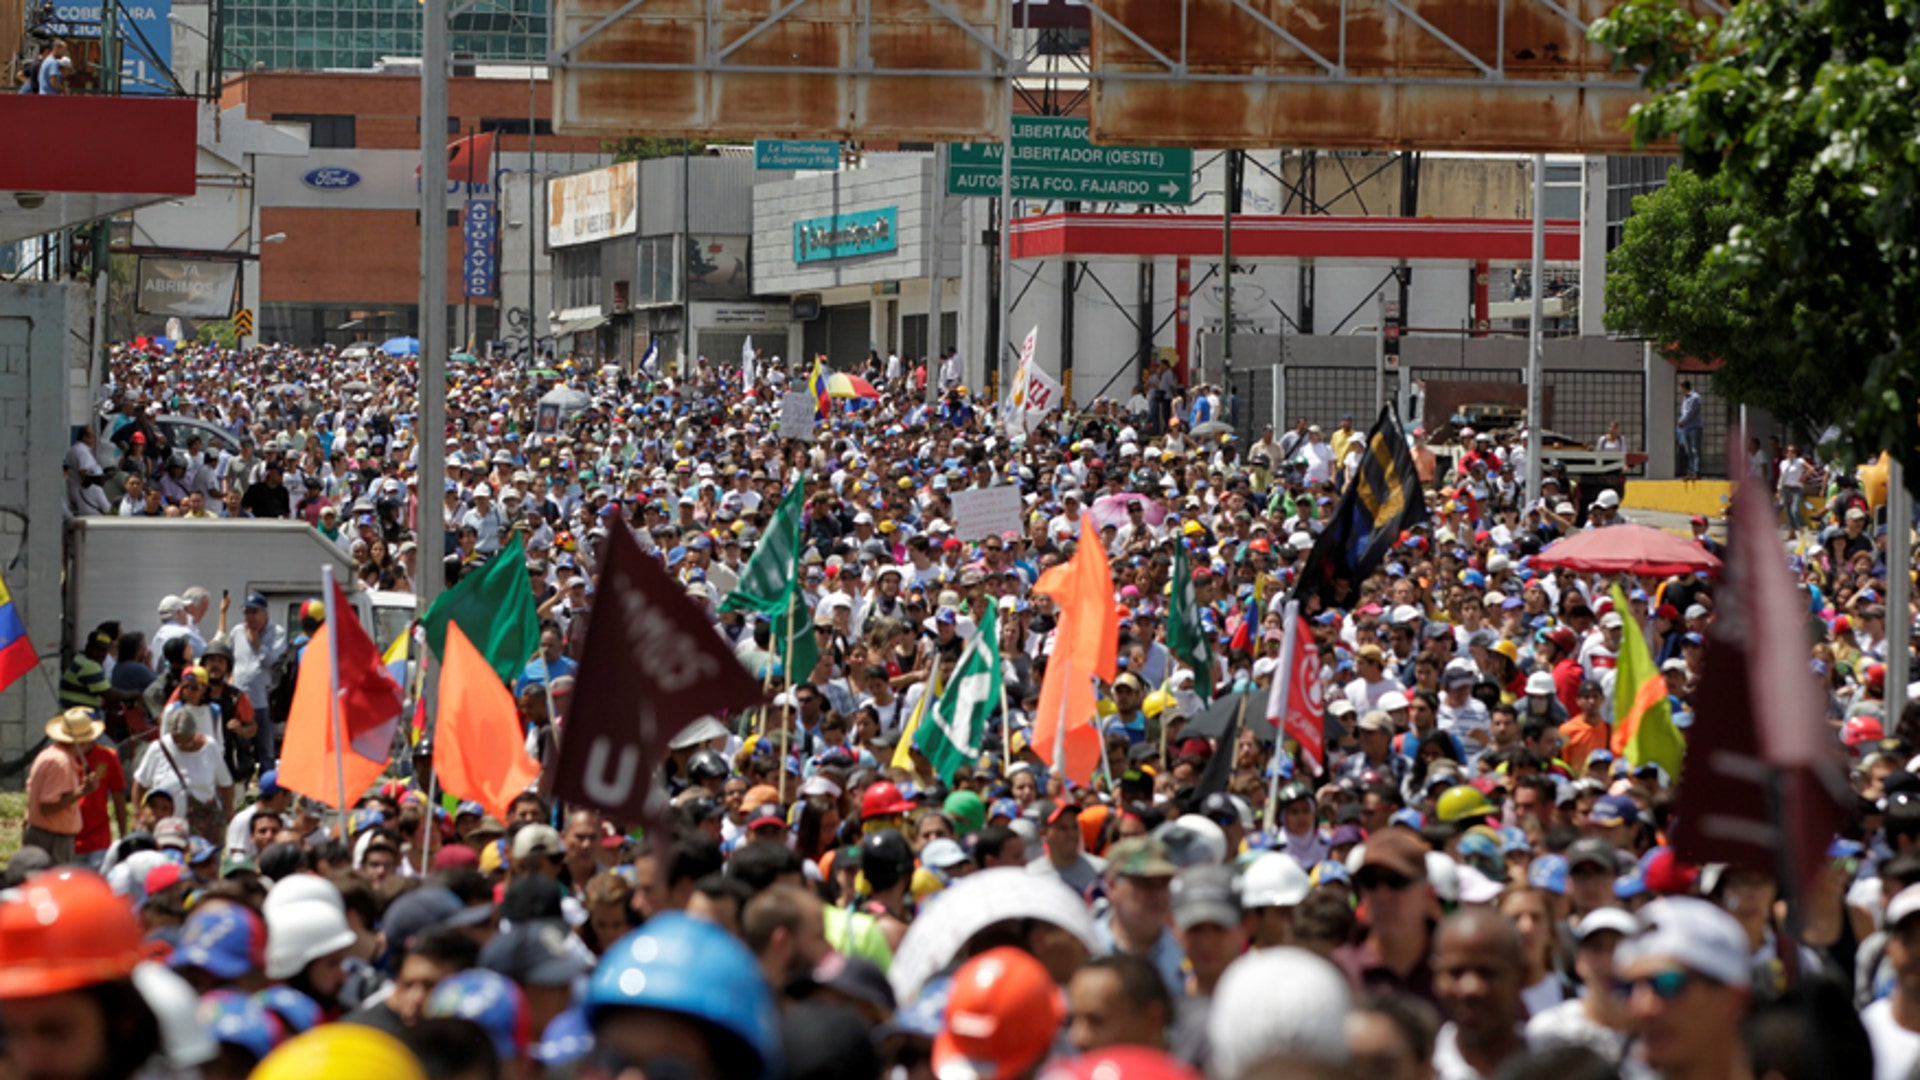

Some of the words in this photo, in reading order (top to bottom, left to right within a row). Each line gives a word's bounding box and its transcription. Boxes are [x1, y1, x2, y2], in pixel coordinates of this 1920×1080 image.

[1011, 124, 1089, 139] LIBERTADO
[1011, 147, 1103, 163] LIBERTADOR
[1105, 150, 1165, 167] (OESTE)
[315, 170, 350, 186] Ford
[1043, 177, 1077, 192] FCO.
[1081, 178, 1150, 195] FAJARDO
[470, 202, 488, 295] AUTOLAVADO
[182, 263, 199, 276] YA
[145, 279, 213, 295] ABRIMOS
